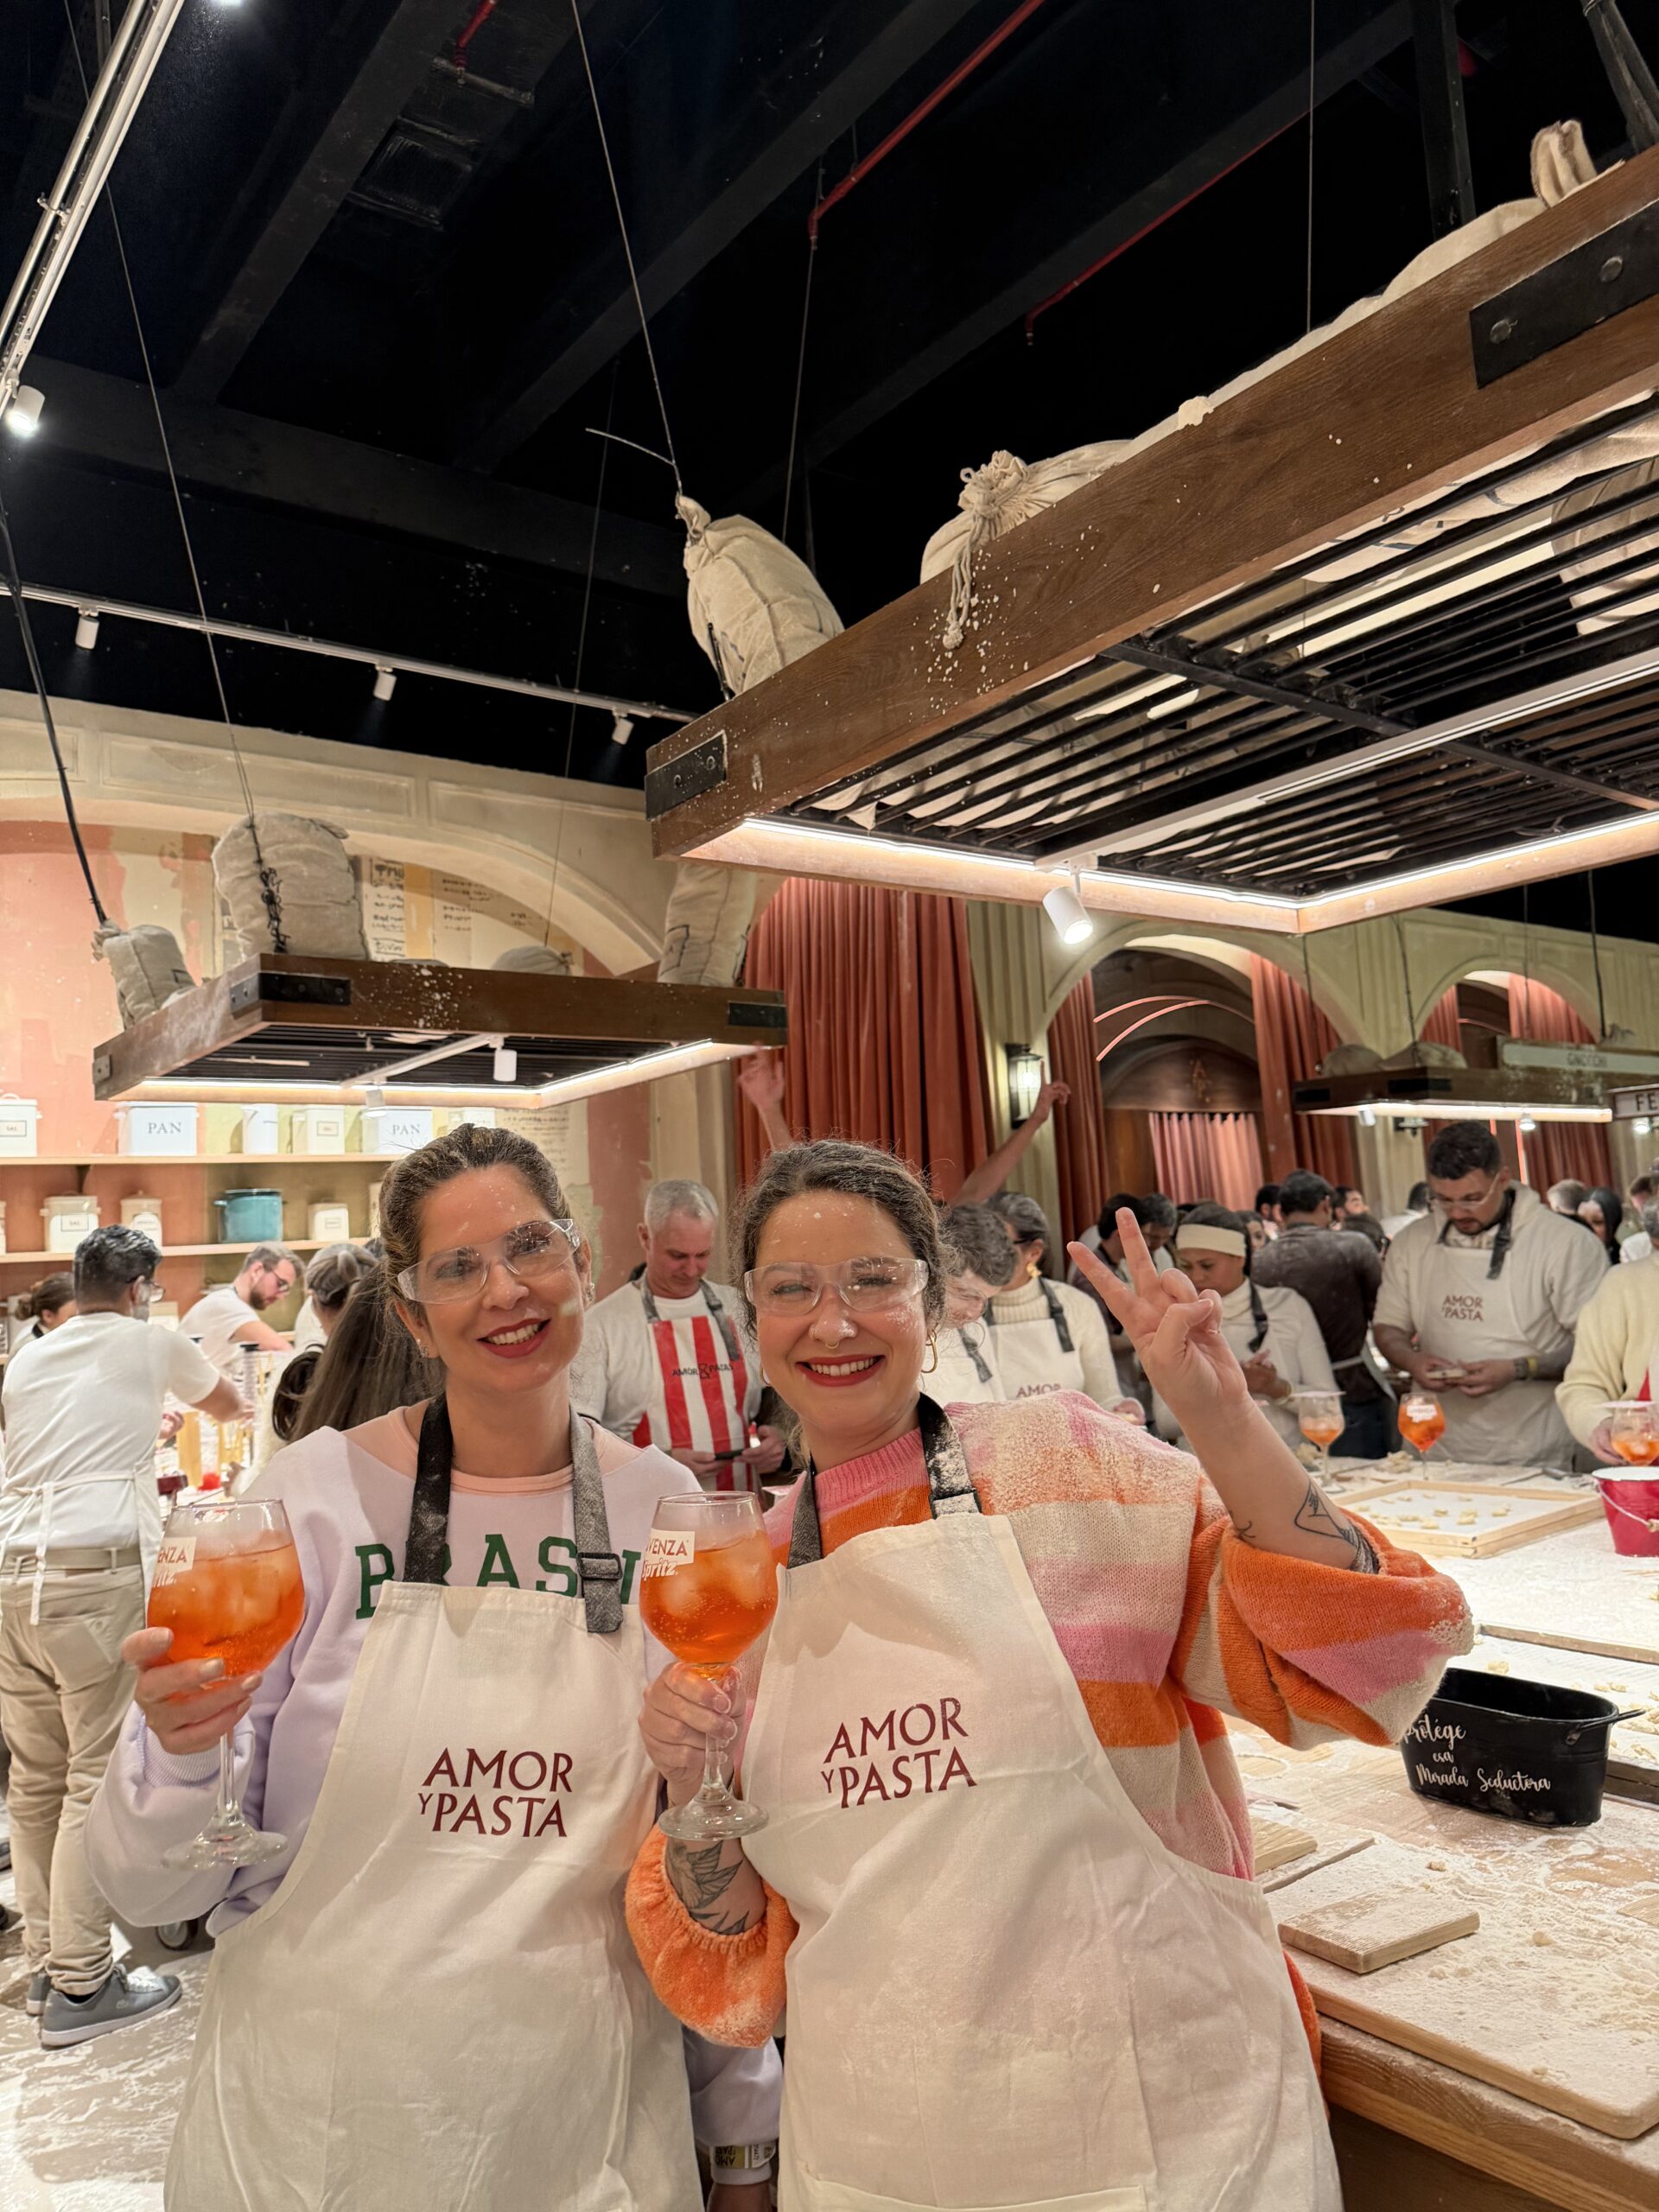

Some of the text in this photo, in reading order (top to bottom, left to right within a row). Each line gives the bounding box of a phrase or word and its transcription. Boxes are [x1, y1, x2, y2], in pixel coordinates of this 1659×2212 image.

[148, 1122, 182, 1134] PAN
[391, 1123, 421, 1135] PAN
[1442, 1295, 1484, 1309] AMOR
[823, 1697, 969, 1764] AMOR
[1433, 1751, 1454, 1764] esa
[422, 1747, 572, 1793] AMOR
[1477, 1767, 1551, 1792] Seductora
